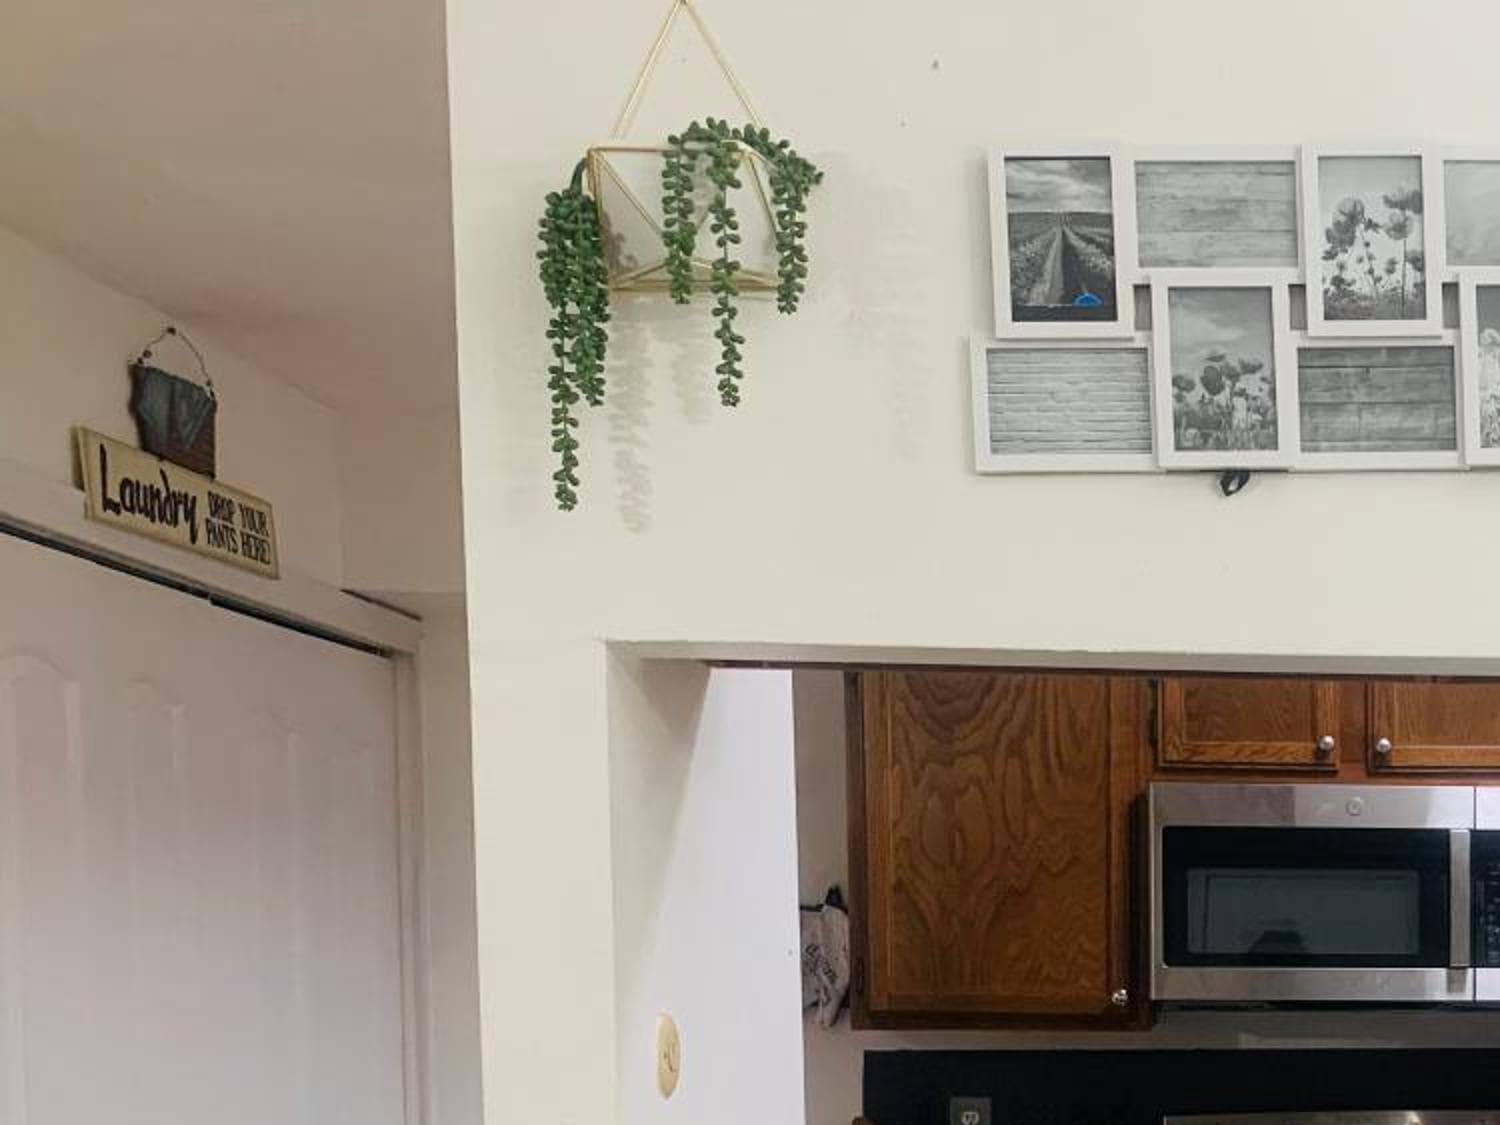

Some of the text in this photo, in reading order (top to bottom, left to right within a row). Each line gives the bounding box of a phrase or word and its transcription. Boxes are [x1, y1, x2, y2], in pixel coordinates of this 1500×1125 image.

[98, 443, 199, 545] Laundry
[205, 517, 239, 554] PANTS
[238, 502, 270, 538] YOUR
